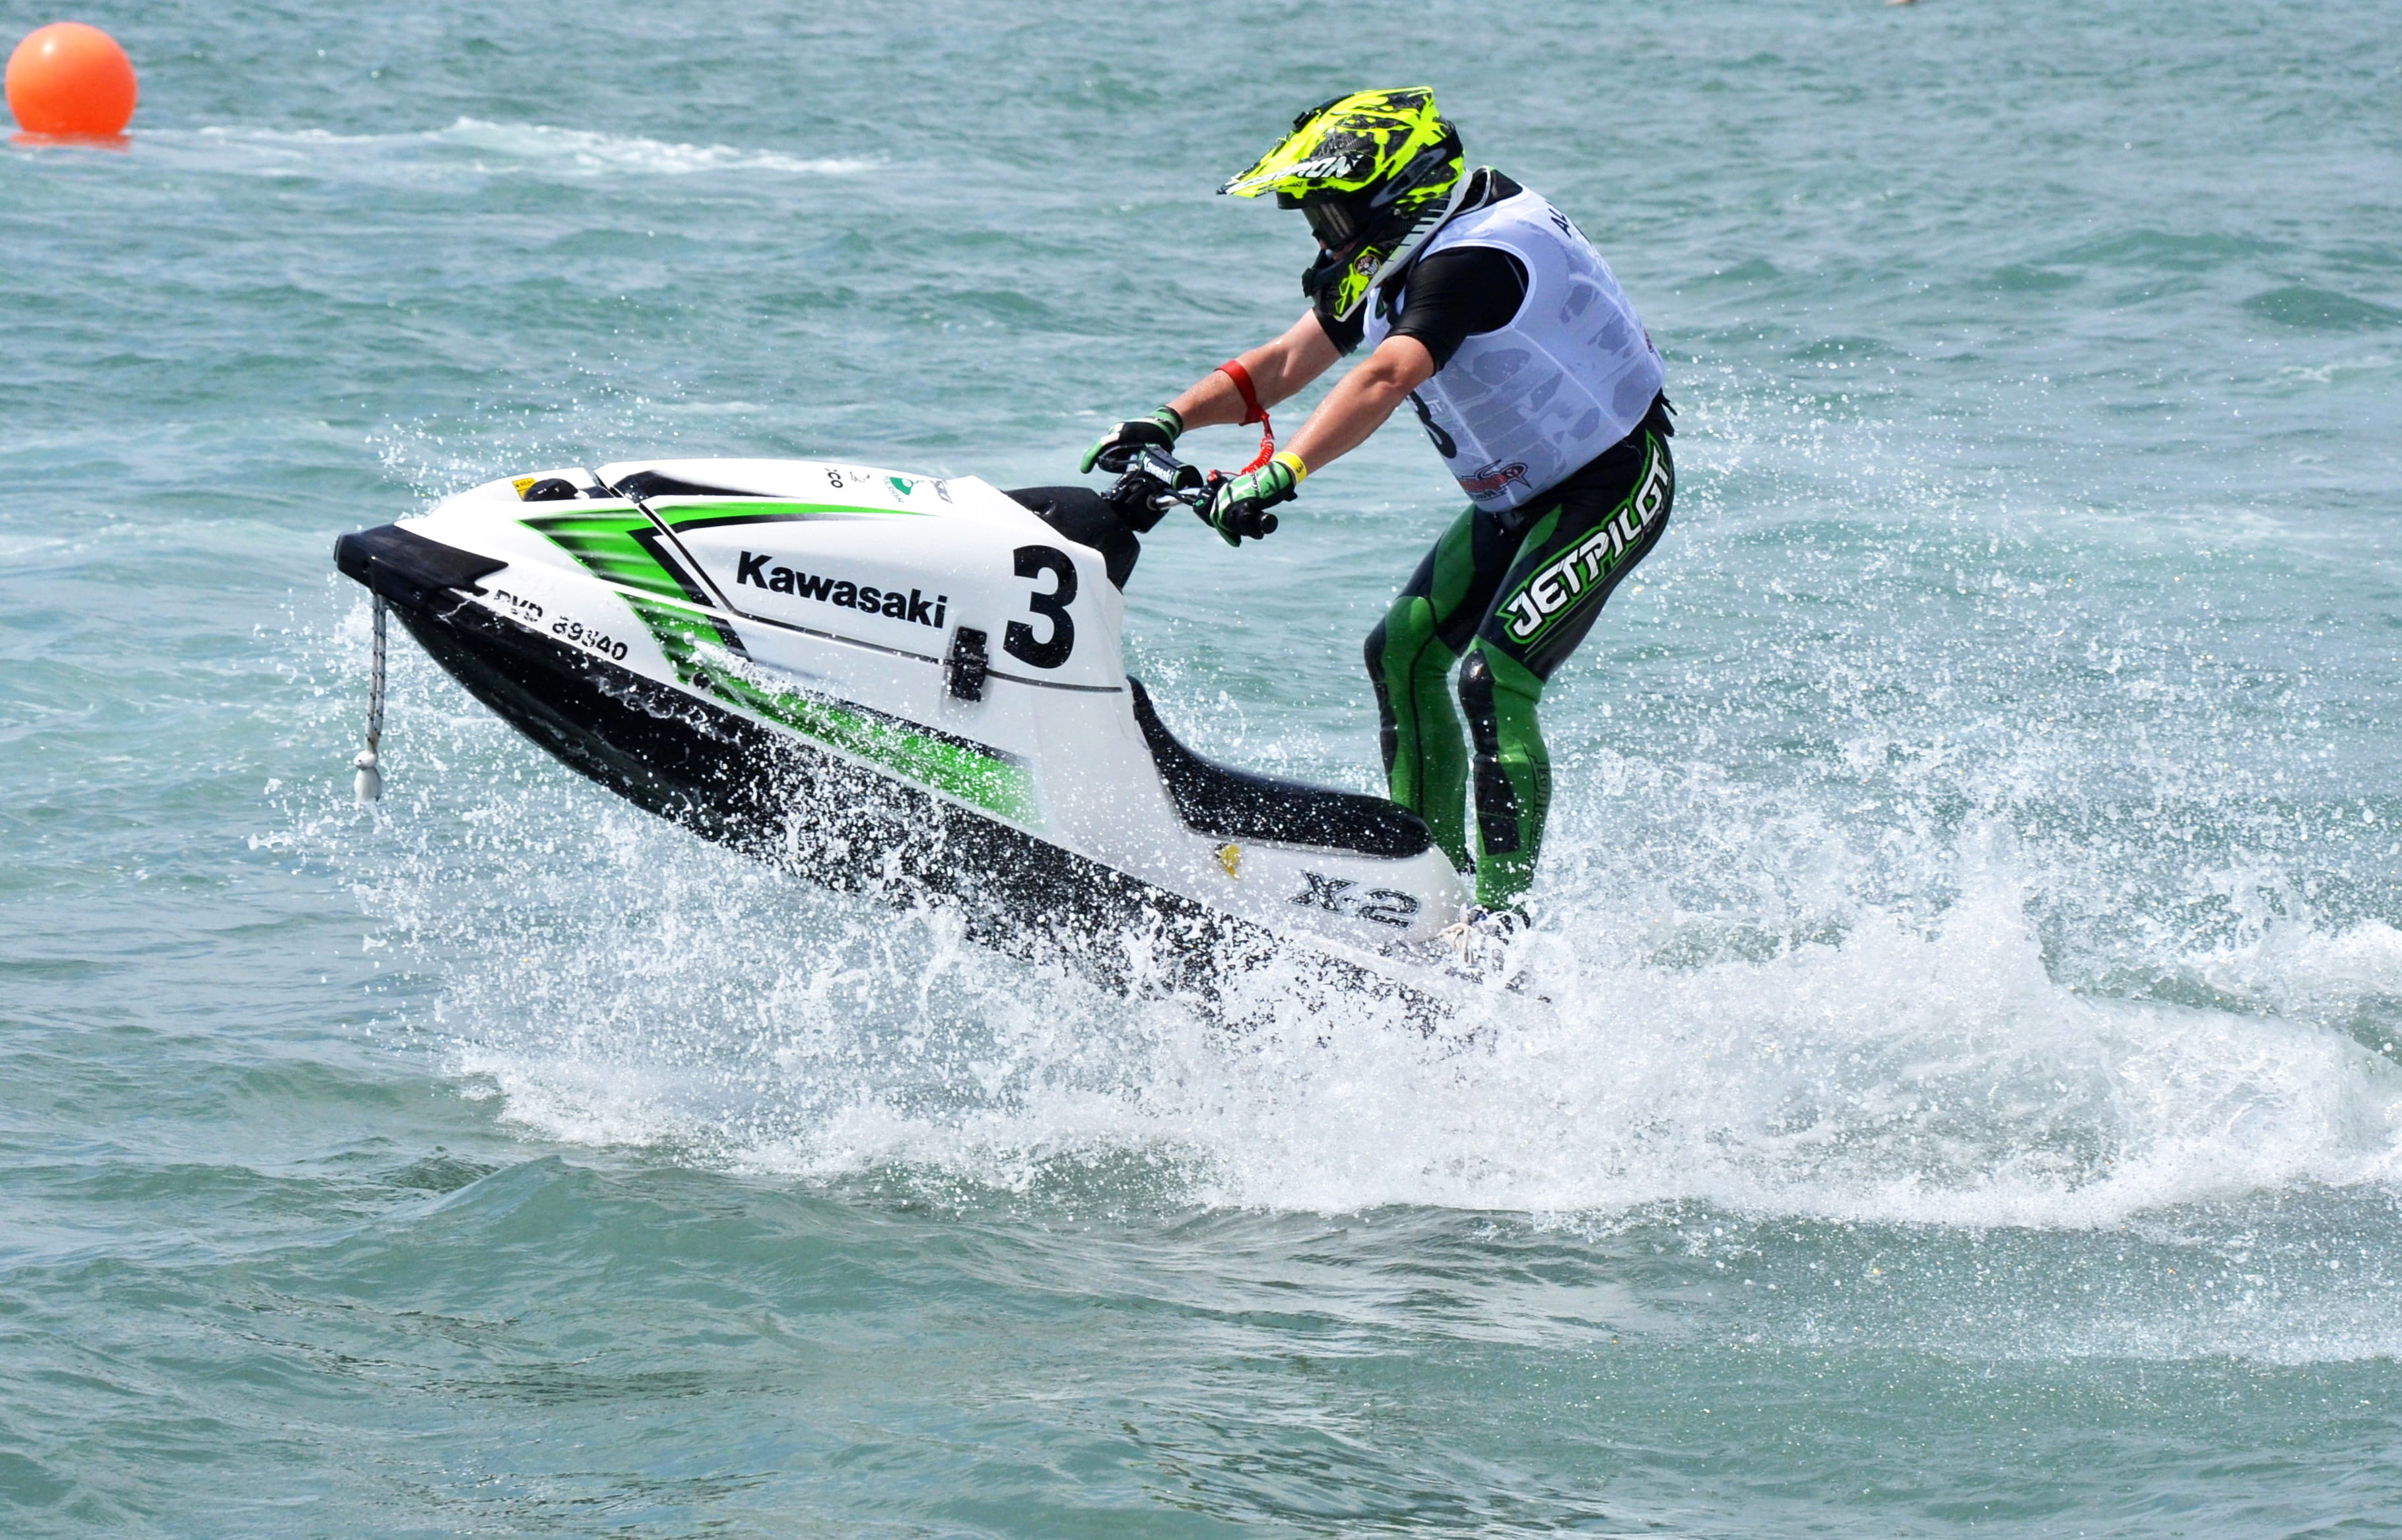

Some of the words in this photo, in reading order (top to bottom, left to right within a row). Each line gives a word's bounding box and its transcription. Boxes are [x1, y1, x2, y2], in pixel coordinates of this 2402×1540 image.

[737, 551, 949, 629] Kawasaki
[1507, 446, 1669, 637] JETPILOT
[1003, 545, 1079, 669] 3
